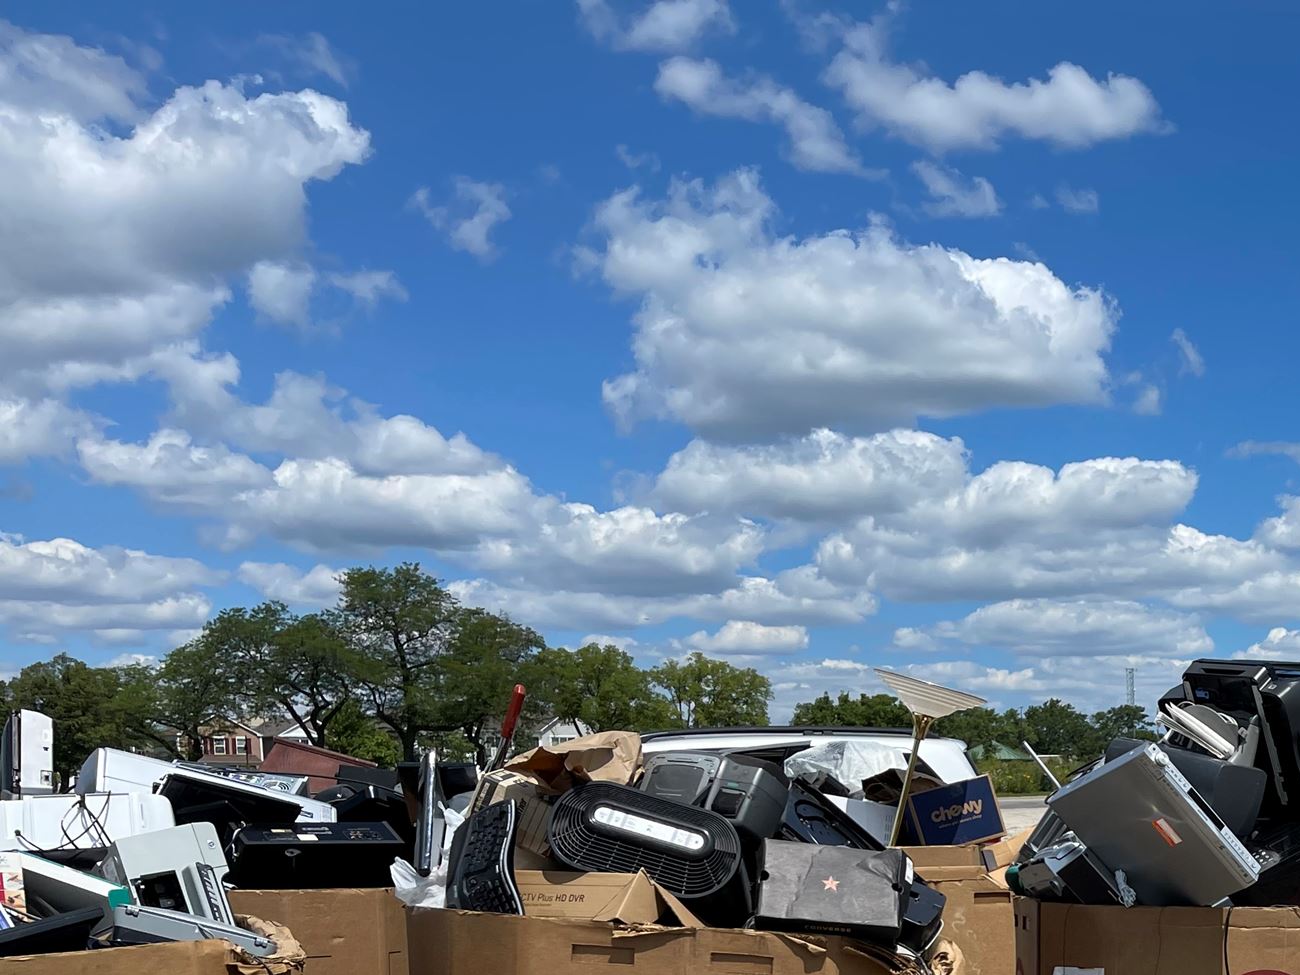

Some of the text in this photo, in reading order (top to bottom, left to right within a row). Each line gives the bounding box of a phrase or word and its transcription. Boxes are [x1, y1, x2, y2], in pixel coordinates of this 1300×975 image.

[931, 799, 982, 823] chewy
[520, 893, 585, 903] CTV Plus HD DVR
[804, 924, 852, 933] CONVERSE
